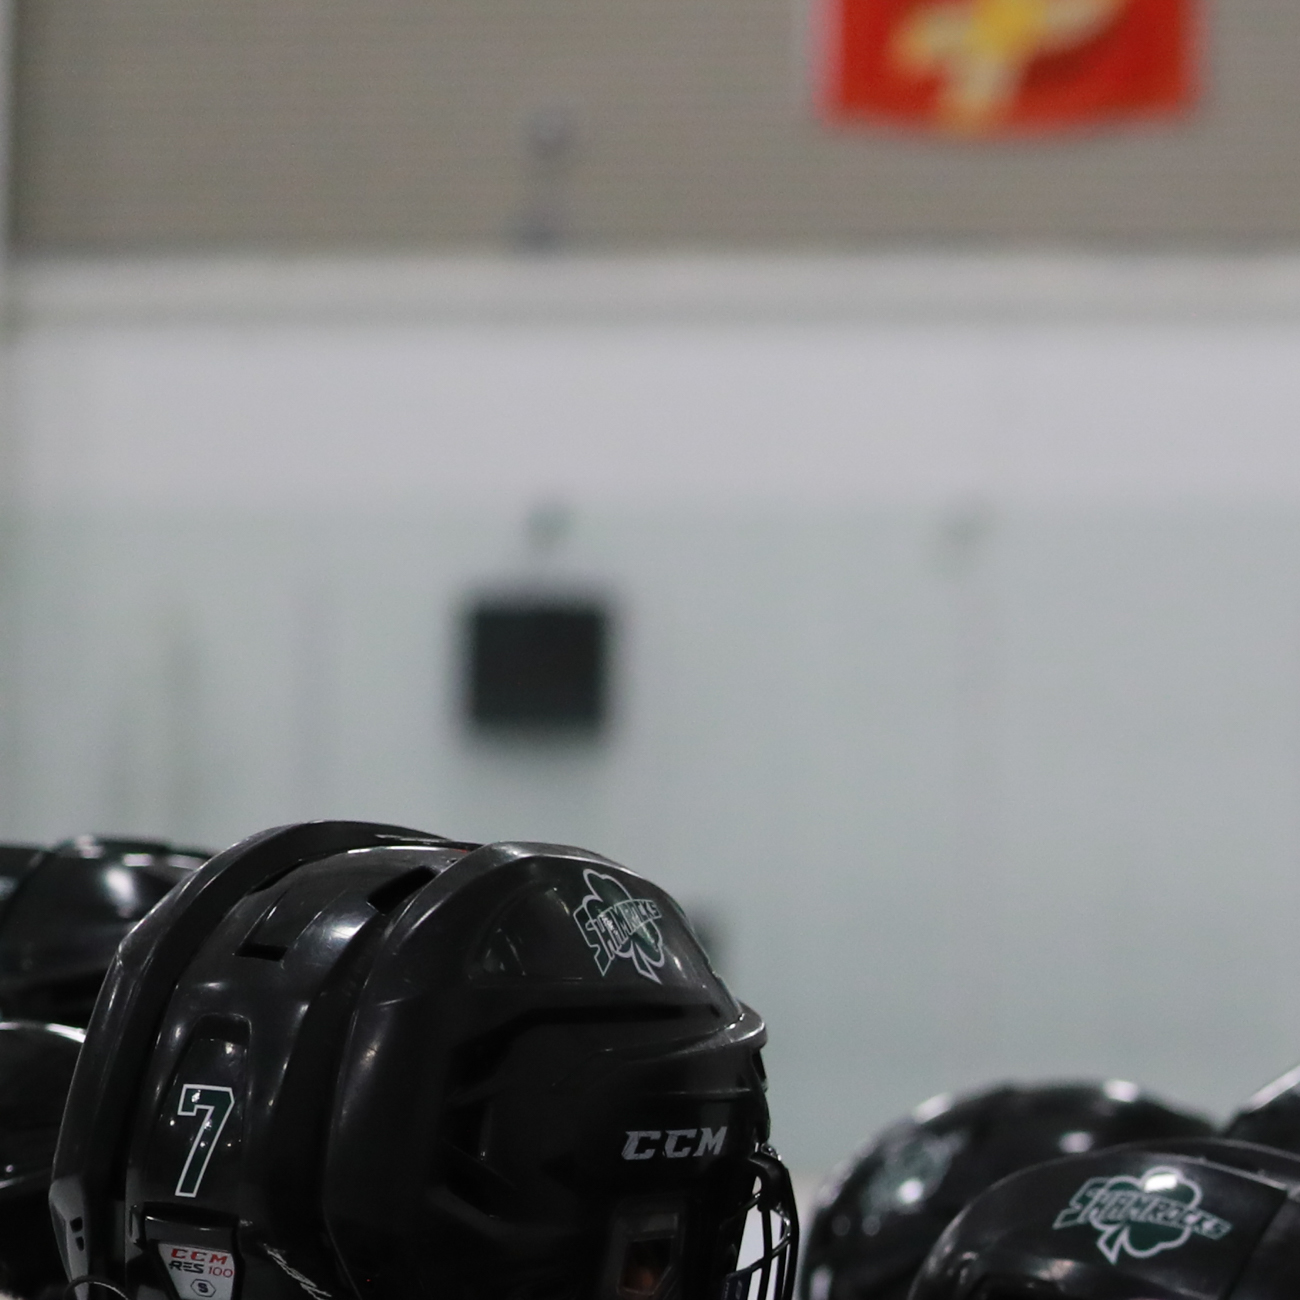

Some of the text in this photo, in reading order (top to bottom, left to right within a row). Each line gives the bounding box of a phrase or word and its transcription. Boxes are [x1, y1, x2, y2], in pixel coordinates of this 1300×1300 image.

[175, 1083, 235, 1198] 7
[621, 1126, 728, 1161] CCM
[169, 1260, 234, 1279] RES 100
[171, 1248, 228, 1265] CCM
